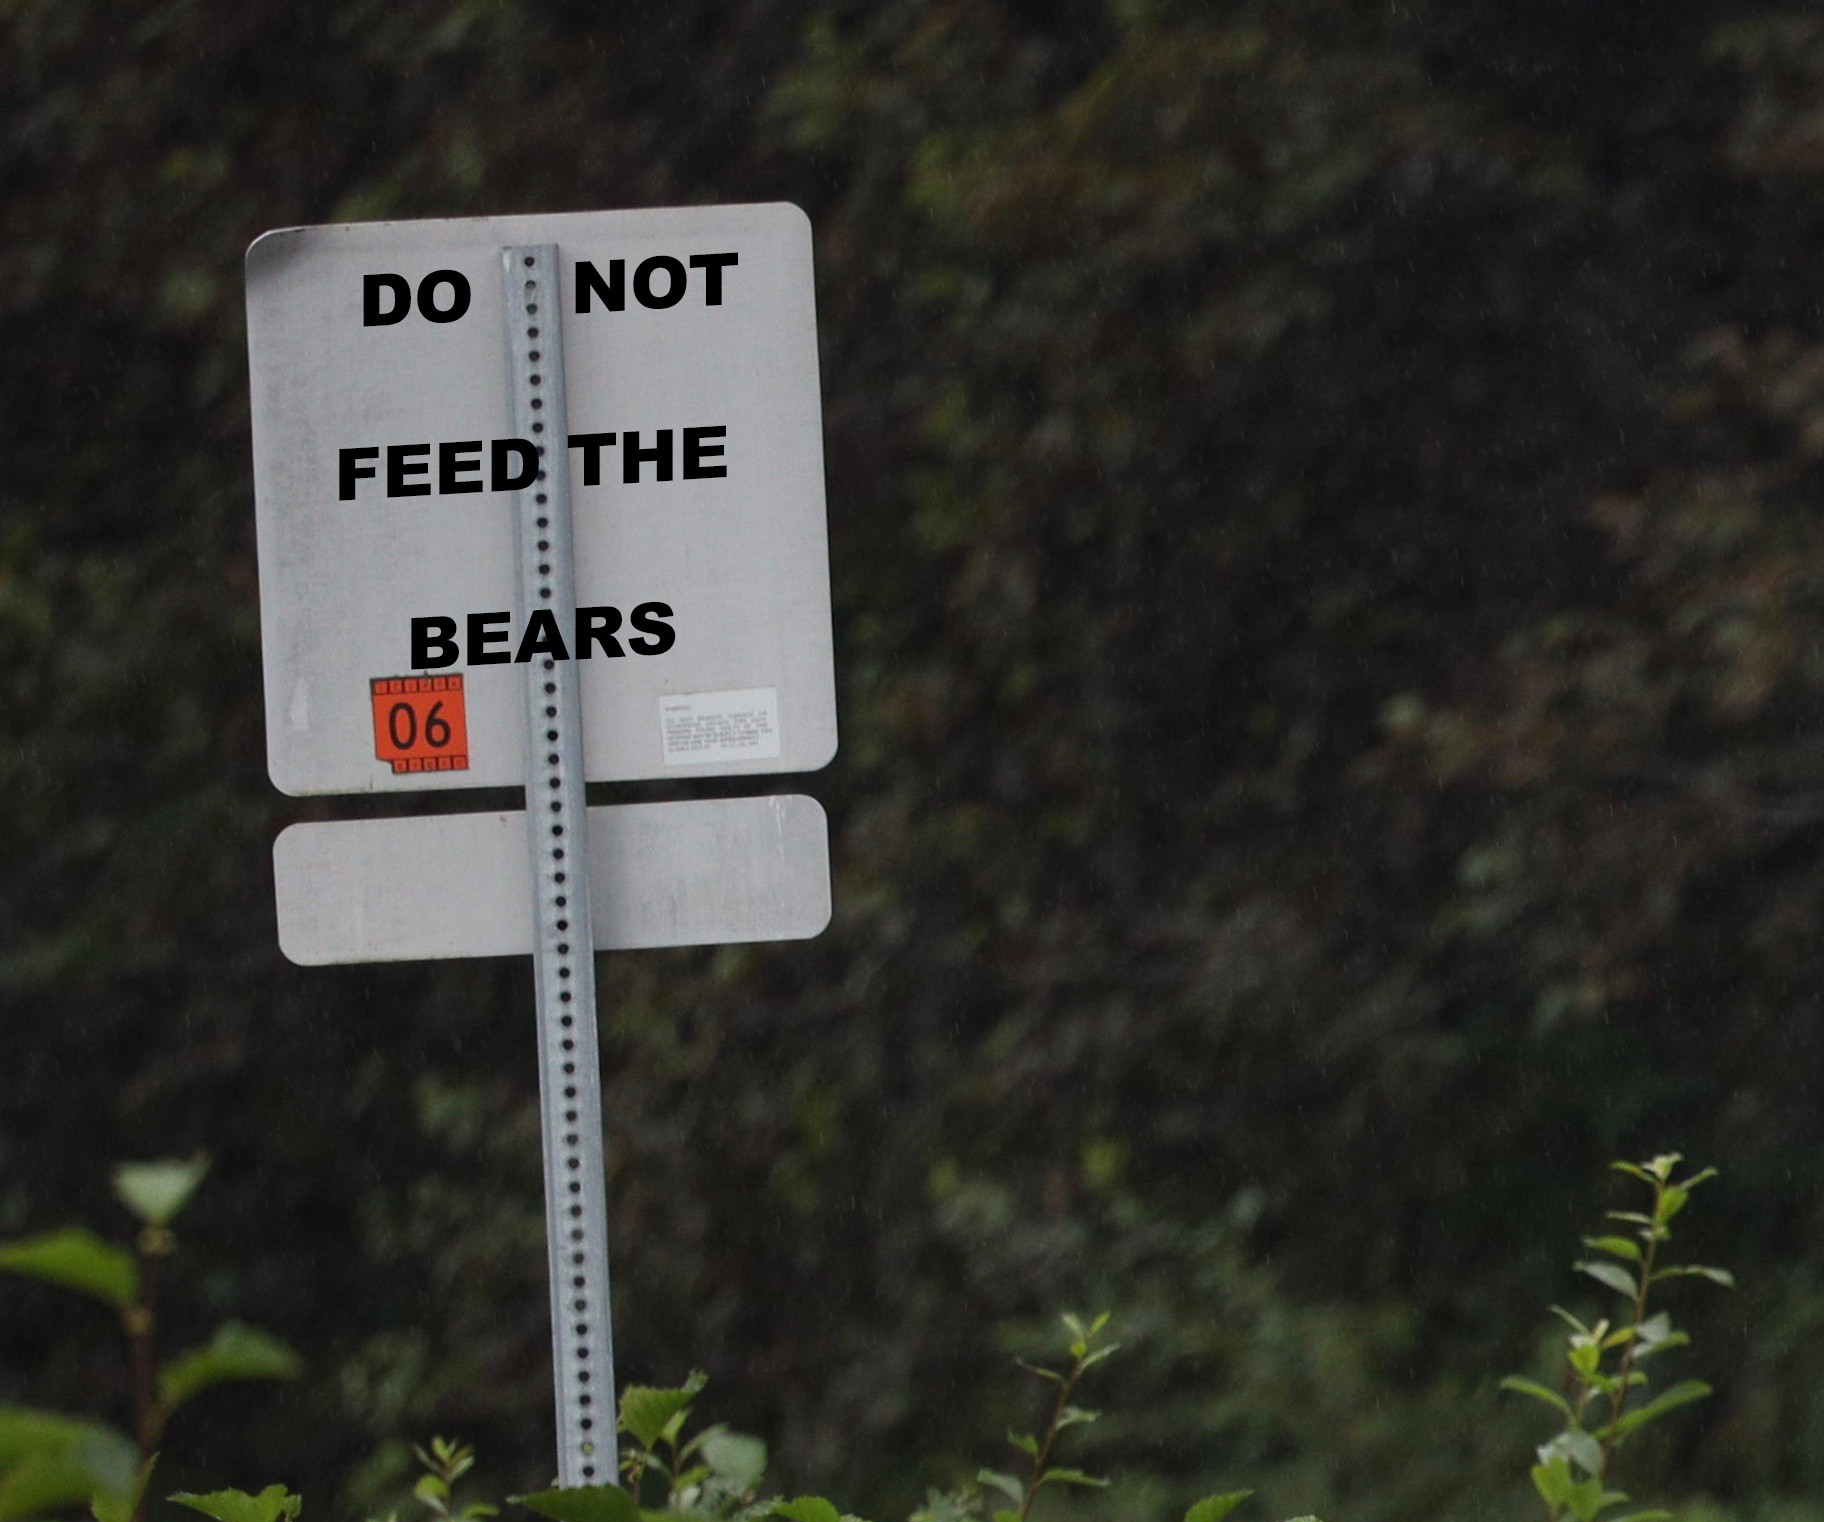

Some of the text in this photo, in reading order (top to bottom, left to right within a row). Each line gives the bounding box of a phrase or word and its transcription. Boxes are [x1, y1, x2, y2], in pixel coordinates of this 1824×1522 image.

[364, 253, 738, 326] DO NOT
[340, 426, 726, 500] FEED THE
[412, 602, 675, 669] BEARS
[389, 700, 451, 750] 06
